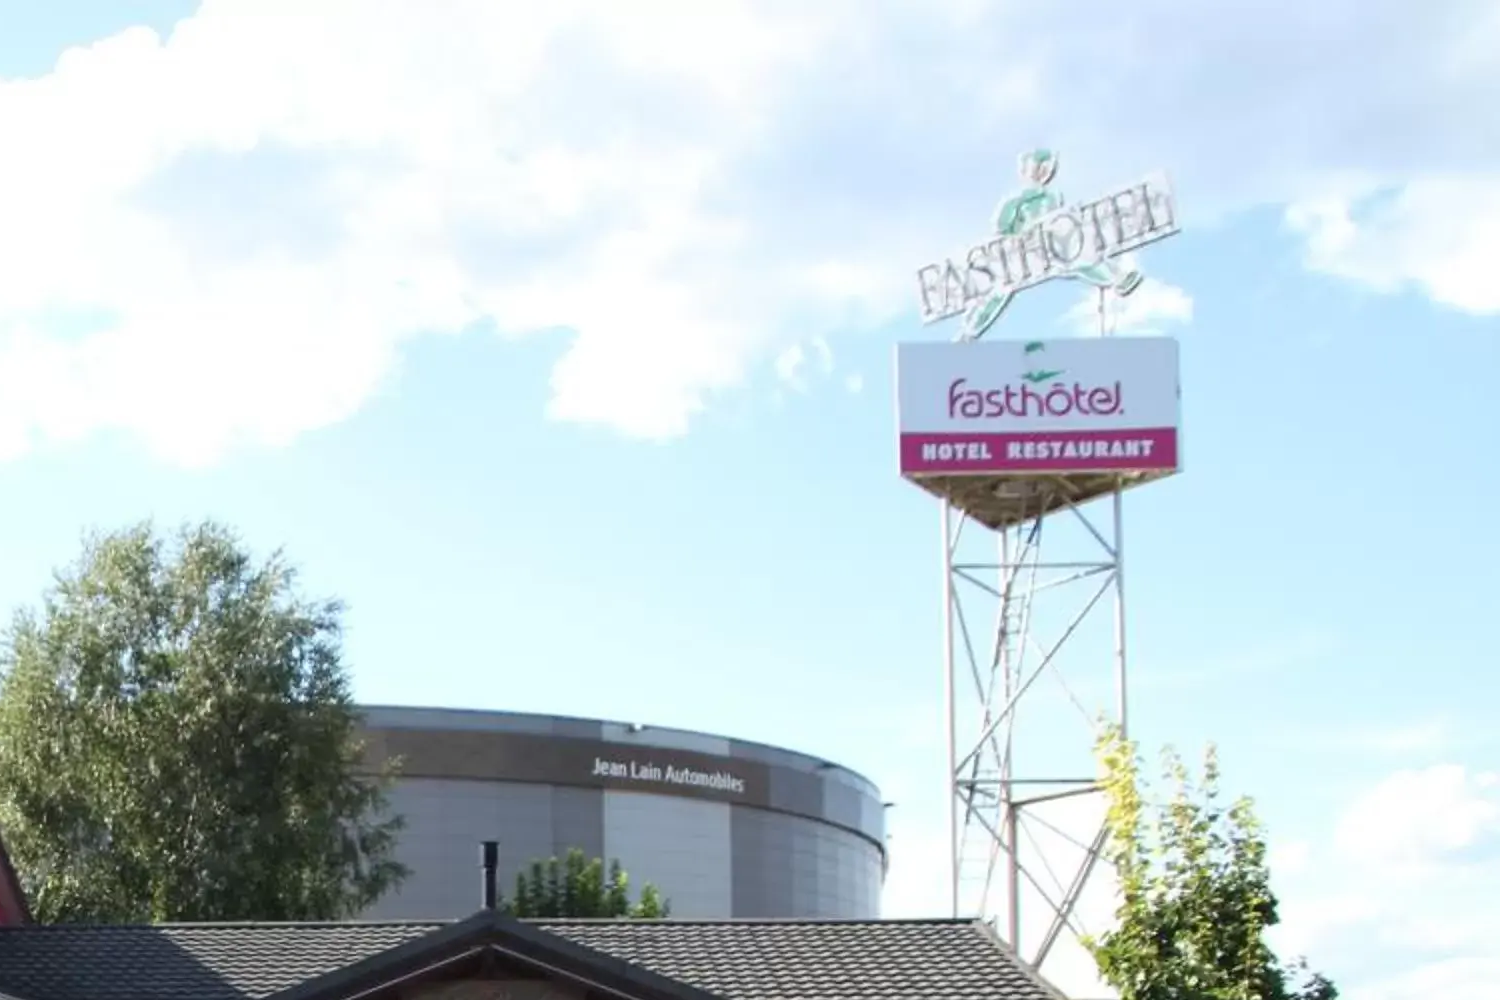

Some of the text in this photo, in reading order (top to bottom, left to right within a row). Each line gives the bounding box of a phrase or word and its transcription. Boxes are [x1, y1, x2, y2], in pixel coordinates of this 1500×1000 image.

[921, 439, 1154, 462] HOTEL RESTAURANT
[592, 757, 746, 793] Jean Lain Automobiles
